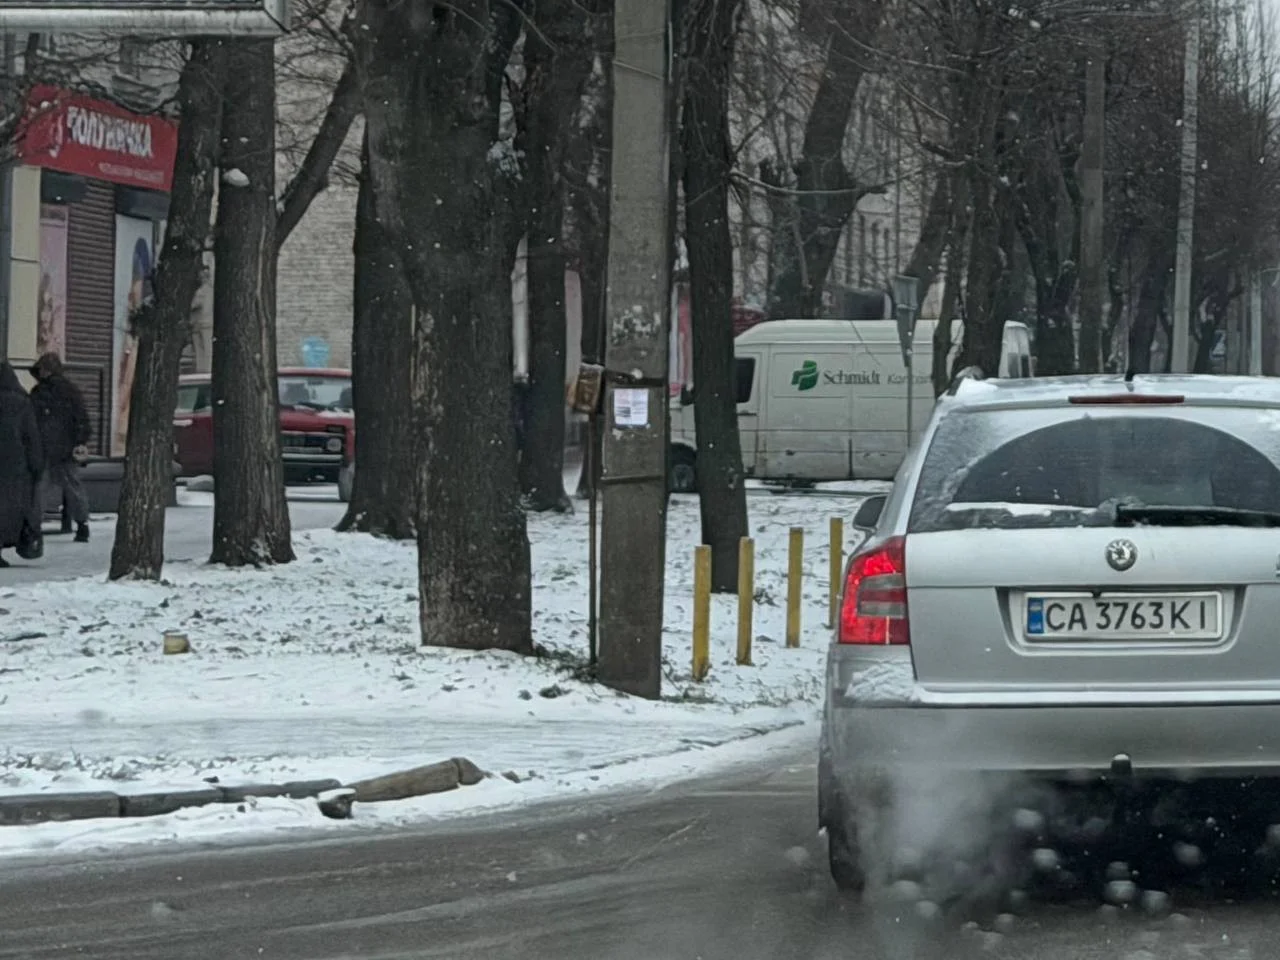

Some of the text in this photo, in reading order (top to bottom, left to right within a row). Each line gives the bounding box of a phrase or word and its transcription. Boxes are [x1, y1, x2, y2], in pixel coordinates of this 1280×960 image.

[823, 370, 881, 385] Schmidt
[1046, 600, 1206, 631] CA 3763 KI
